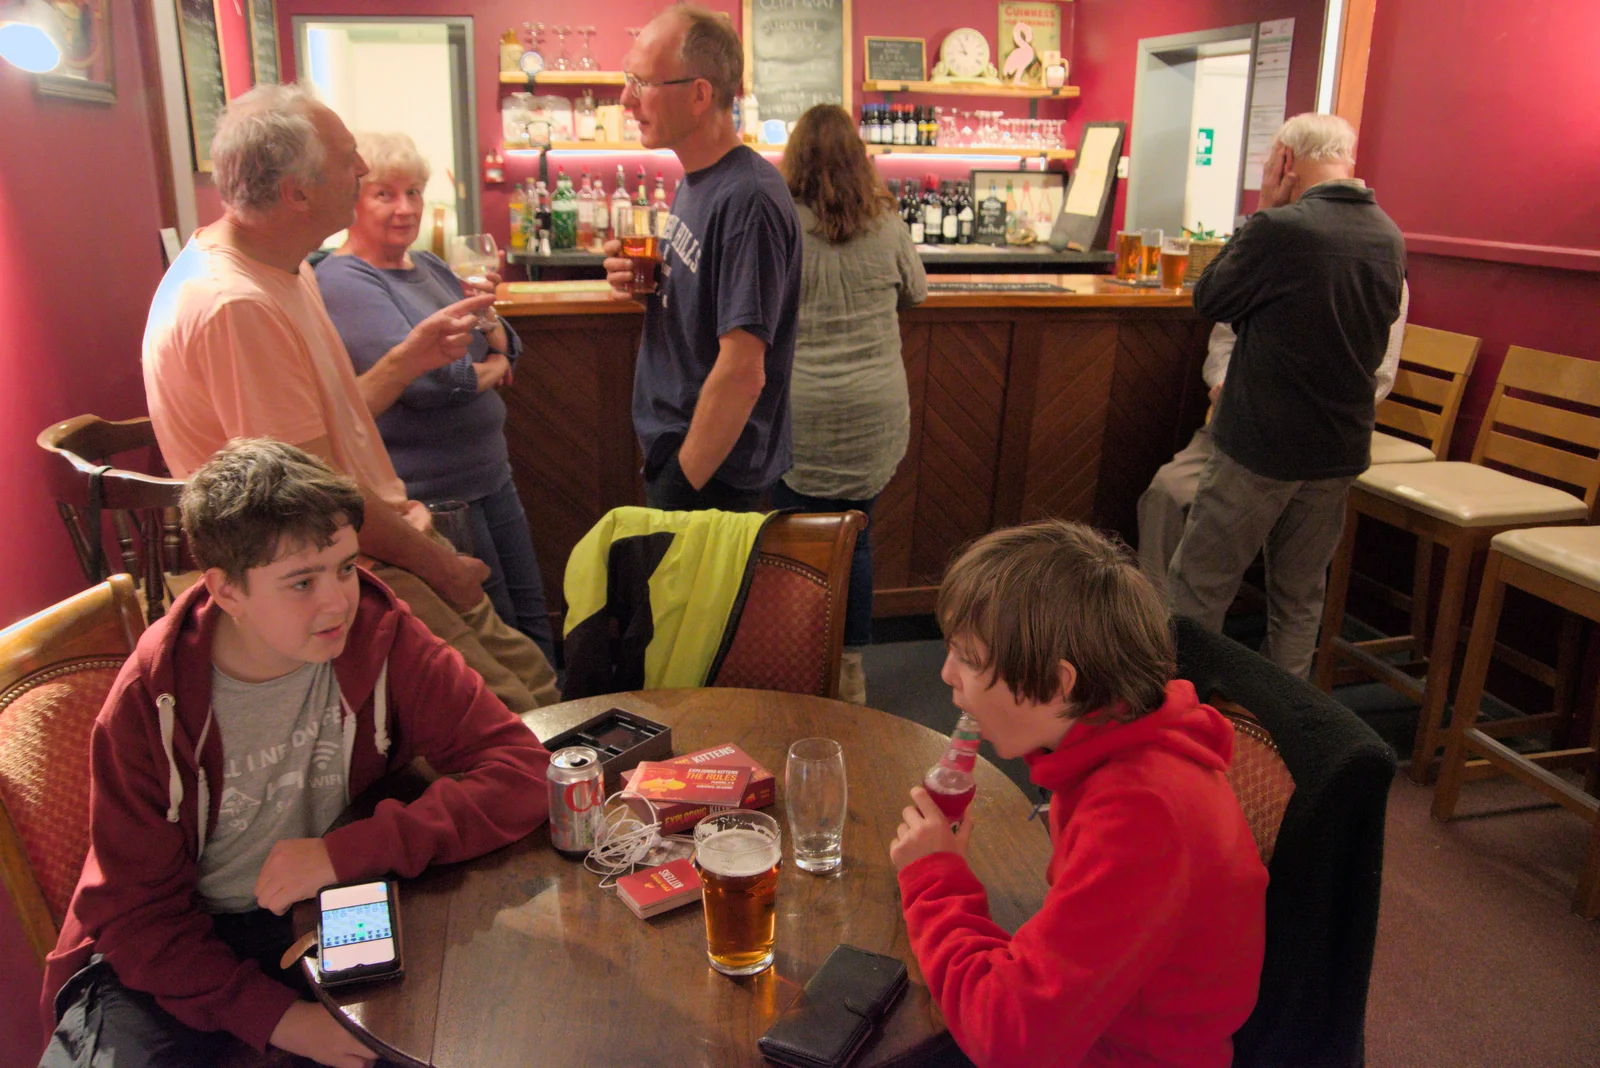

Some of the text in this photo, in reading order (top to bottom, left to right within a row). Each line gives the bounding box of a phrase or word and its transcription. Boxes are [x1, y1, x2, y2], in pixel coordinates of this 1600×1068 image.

[1004, 5, 1056, 18] GUINNESS
[671, 221, 702, 274] HILLS
[691, 746, 736, 765] KITTENS
[309, 774, 342, 788] WIFI
[686, 772, 737, 782] THE RULES
[664, 807, 708, 829] EXPLODING
[658, 868, 685, 890] KITTENS
